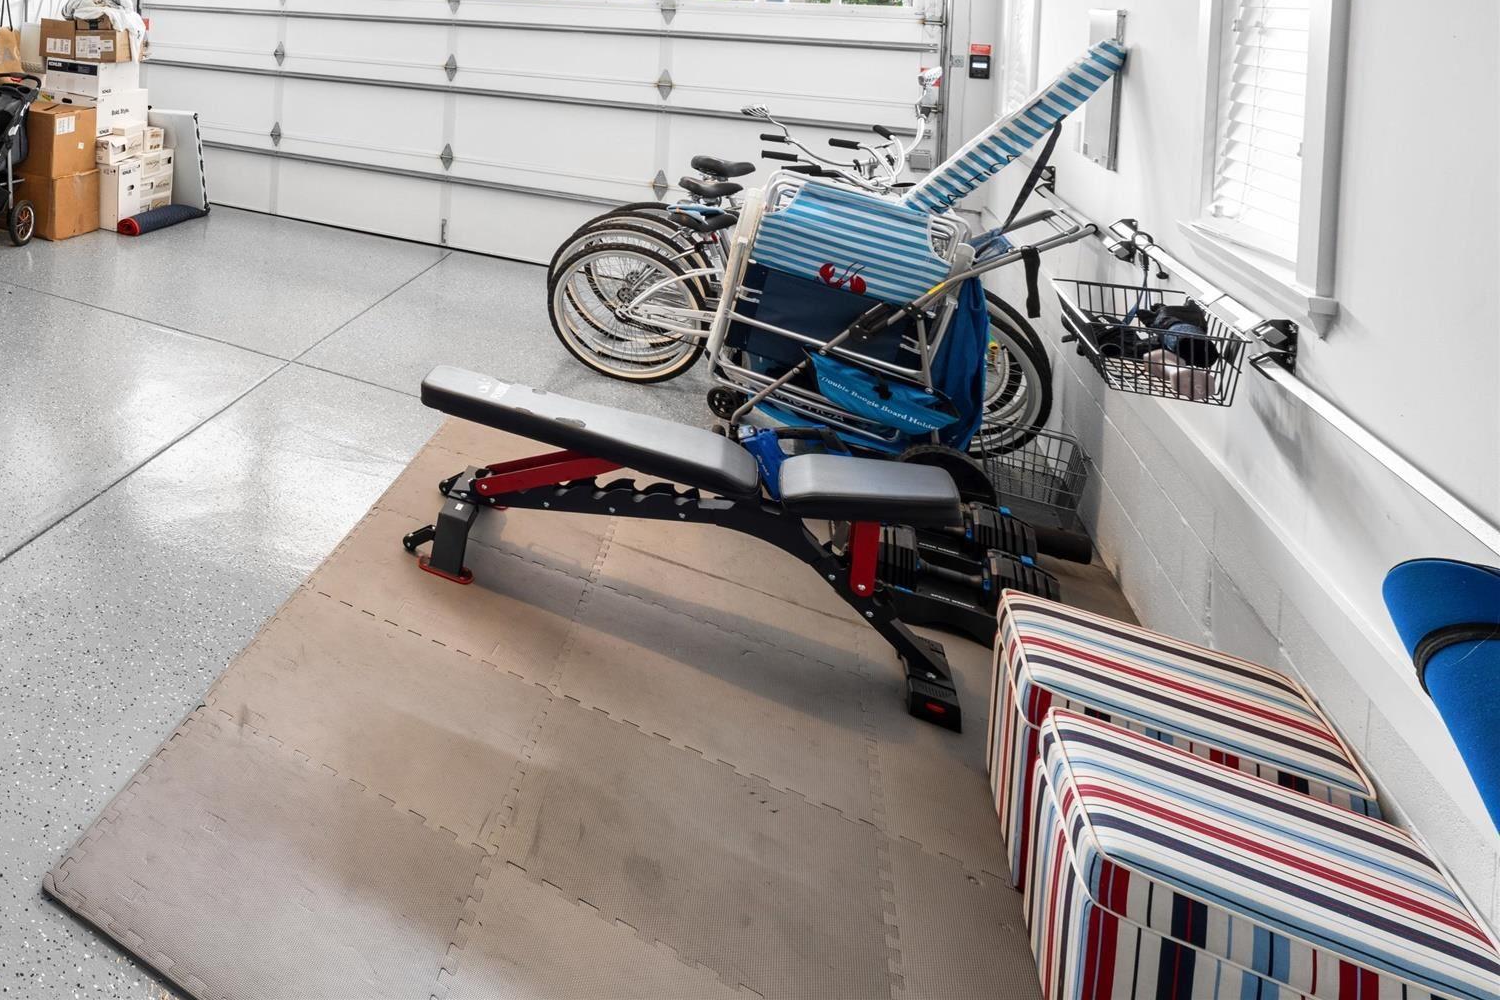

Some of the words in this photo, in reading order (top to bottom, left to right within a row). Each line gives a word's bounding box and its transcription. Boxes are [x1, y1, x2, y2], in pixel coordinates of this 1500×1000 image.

[930, 154, 1021, 212] NAUTICA
[820, 375, 849, 393] Double
[850, 390, 880, 408] Boogie
[881, 404, 907, 420] Board
